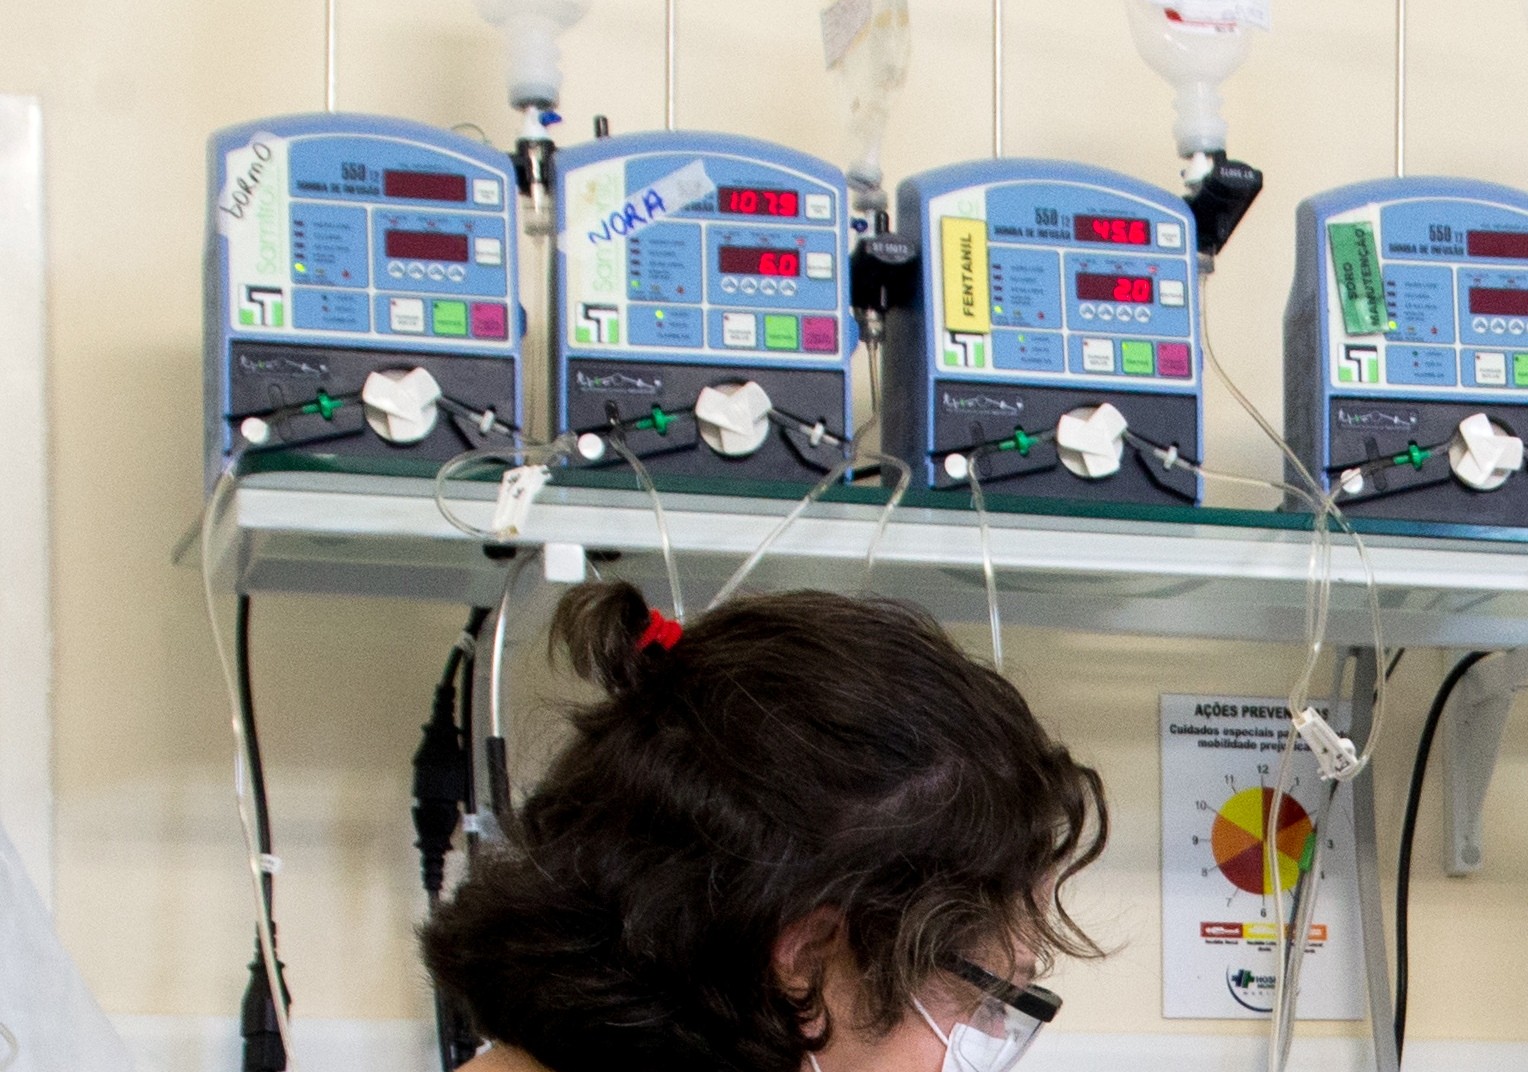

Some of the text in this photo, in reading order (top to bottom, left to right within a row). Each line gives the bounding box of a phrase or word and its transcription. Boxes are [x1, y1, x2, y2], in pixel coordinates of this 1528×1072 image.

[588, 188, 666, 244] NORA
[1034, 206, 1058, 226] 550
[1024, 227, 1033, 238] DE
[1429, 224, 1451, 242] 550
[1418, 244, 1428, 254] DE
[960, 232, 975, 318] FENTANIL
[1343, 261, 1358, 300] SORO
[1355, 228, 1380, 326] MANUTENÇÃO
[1194, 701, 1238, 719] AÇÕES
[1169, 723, 1219, 736] Cuidados
[1223, 726, 1274, 739] especiais
[1198, 738, 1256, 750] mobilidade
[1257, 765, 1269, 774] 12
[1225, 775, 1300, 786] 11 1
[1195, 800, 1207, 811] 10
[1192, 835, 1334, 849] 9 3
[1226, 897, 1232, 907] 7
[1260, 907, 1267, 918] 6
